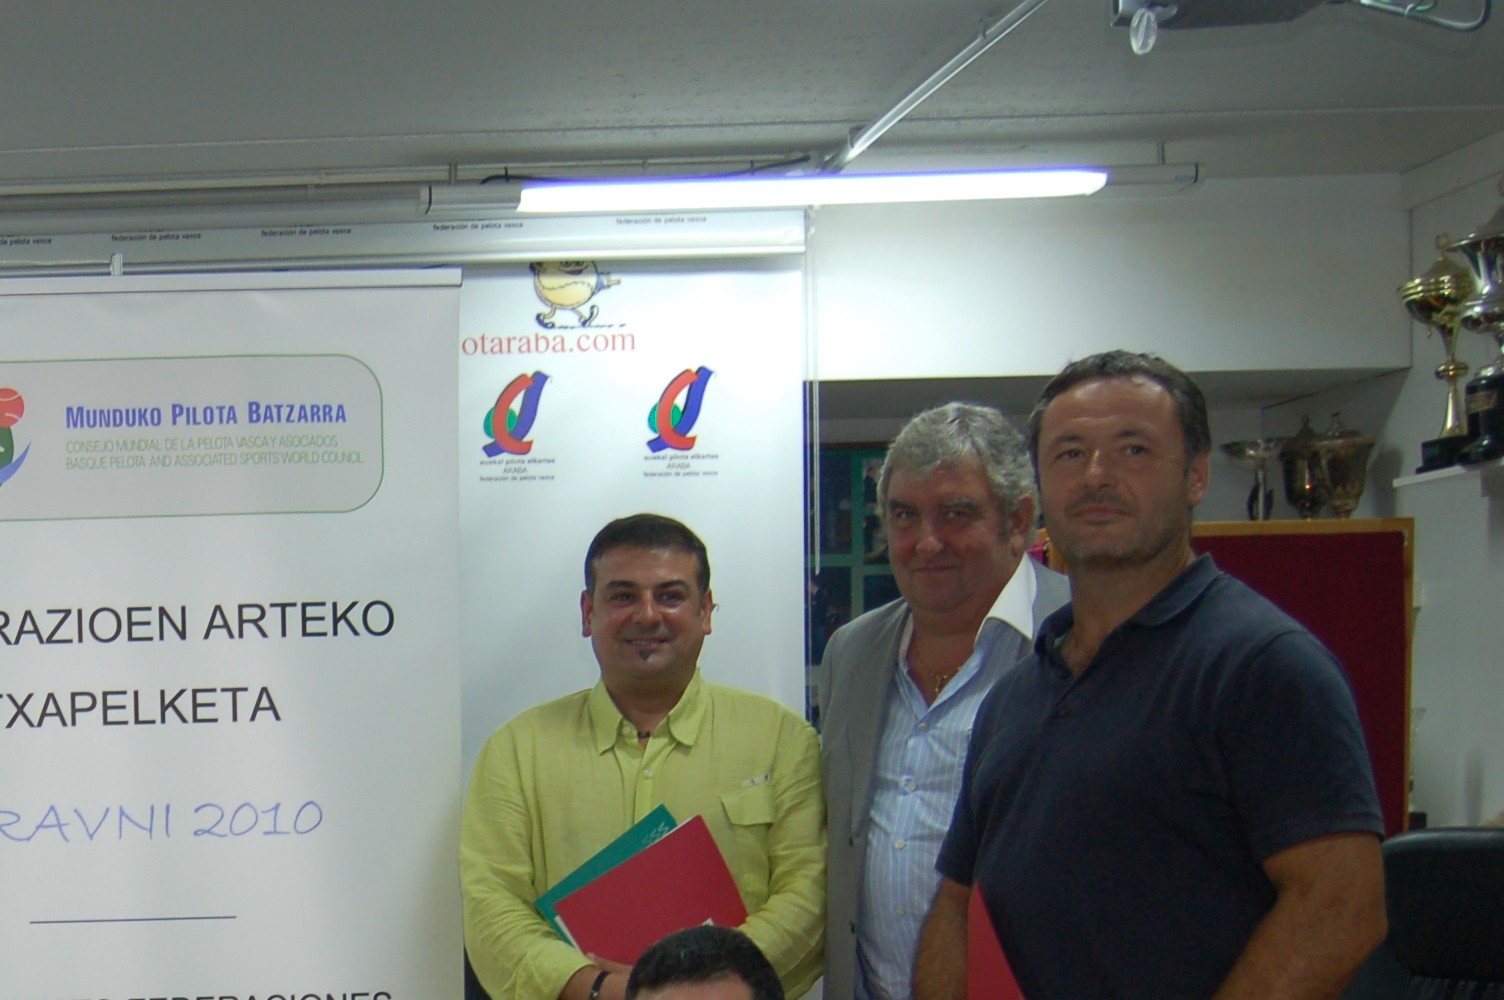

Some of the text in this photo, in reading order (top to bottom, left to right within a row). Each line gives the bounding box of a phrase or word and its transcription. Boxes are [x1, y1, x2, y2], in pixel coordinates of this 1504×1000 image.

[0, 238, 8, 246] de
[462, 331, 636, 356] otaraba.com
[66, 401, 348, 429] MUNDUKO PILOTA BATZARRA
[66, 439, 114, 454] CONSEJO
[116, 438, 162, 452] MUNDIAL
[164, 437, 179, 451] DE
[181, 437, 195, 450] LA
[197, 436, 234, 450] PELOTA
[236, 436, 268, 449] VASCA
[279, 434, 338, 448] ASOCIADOS
[66, 450, 364, 470] BASQUE PELOTA AND ASSOCIATED SPORTS WORLD COUNCIL
[203, 600, 396, 640] ARTEKO
[193, 800, 324, 838] 2010
